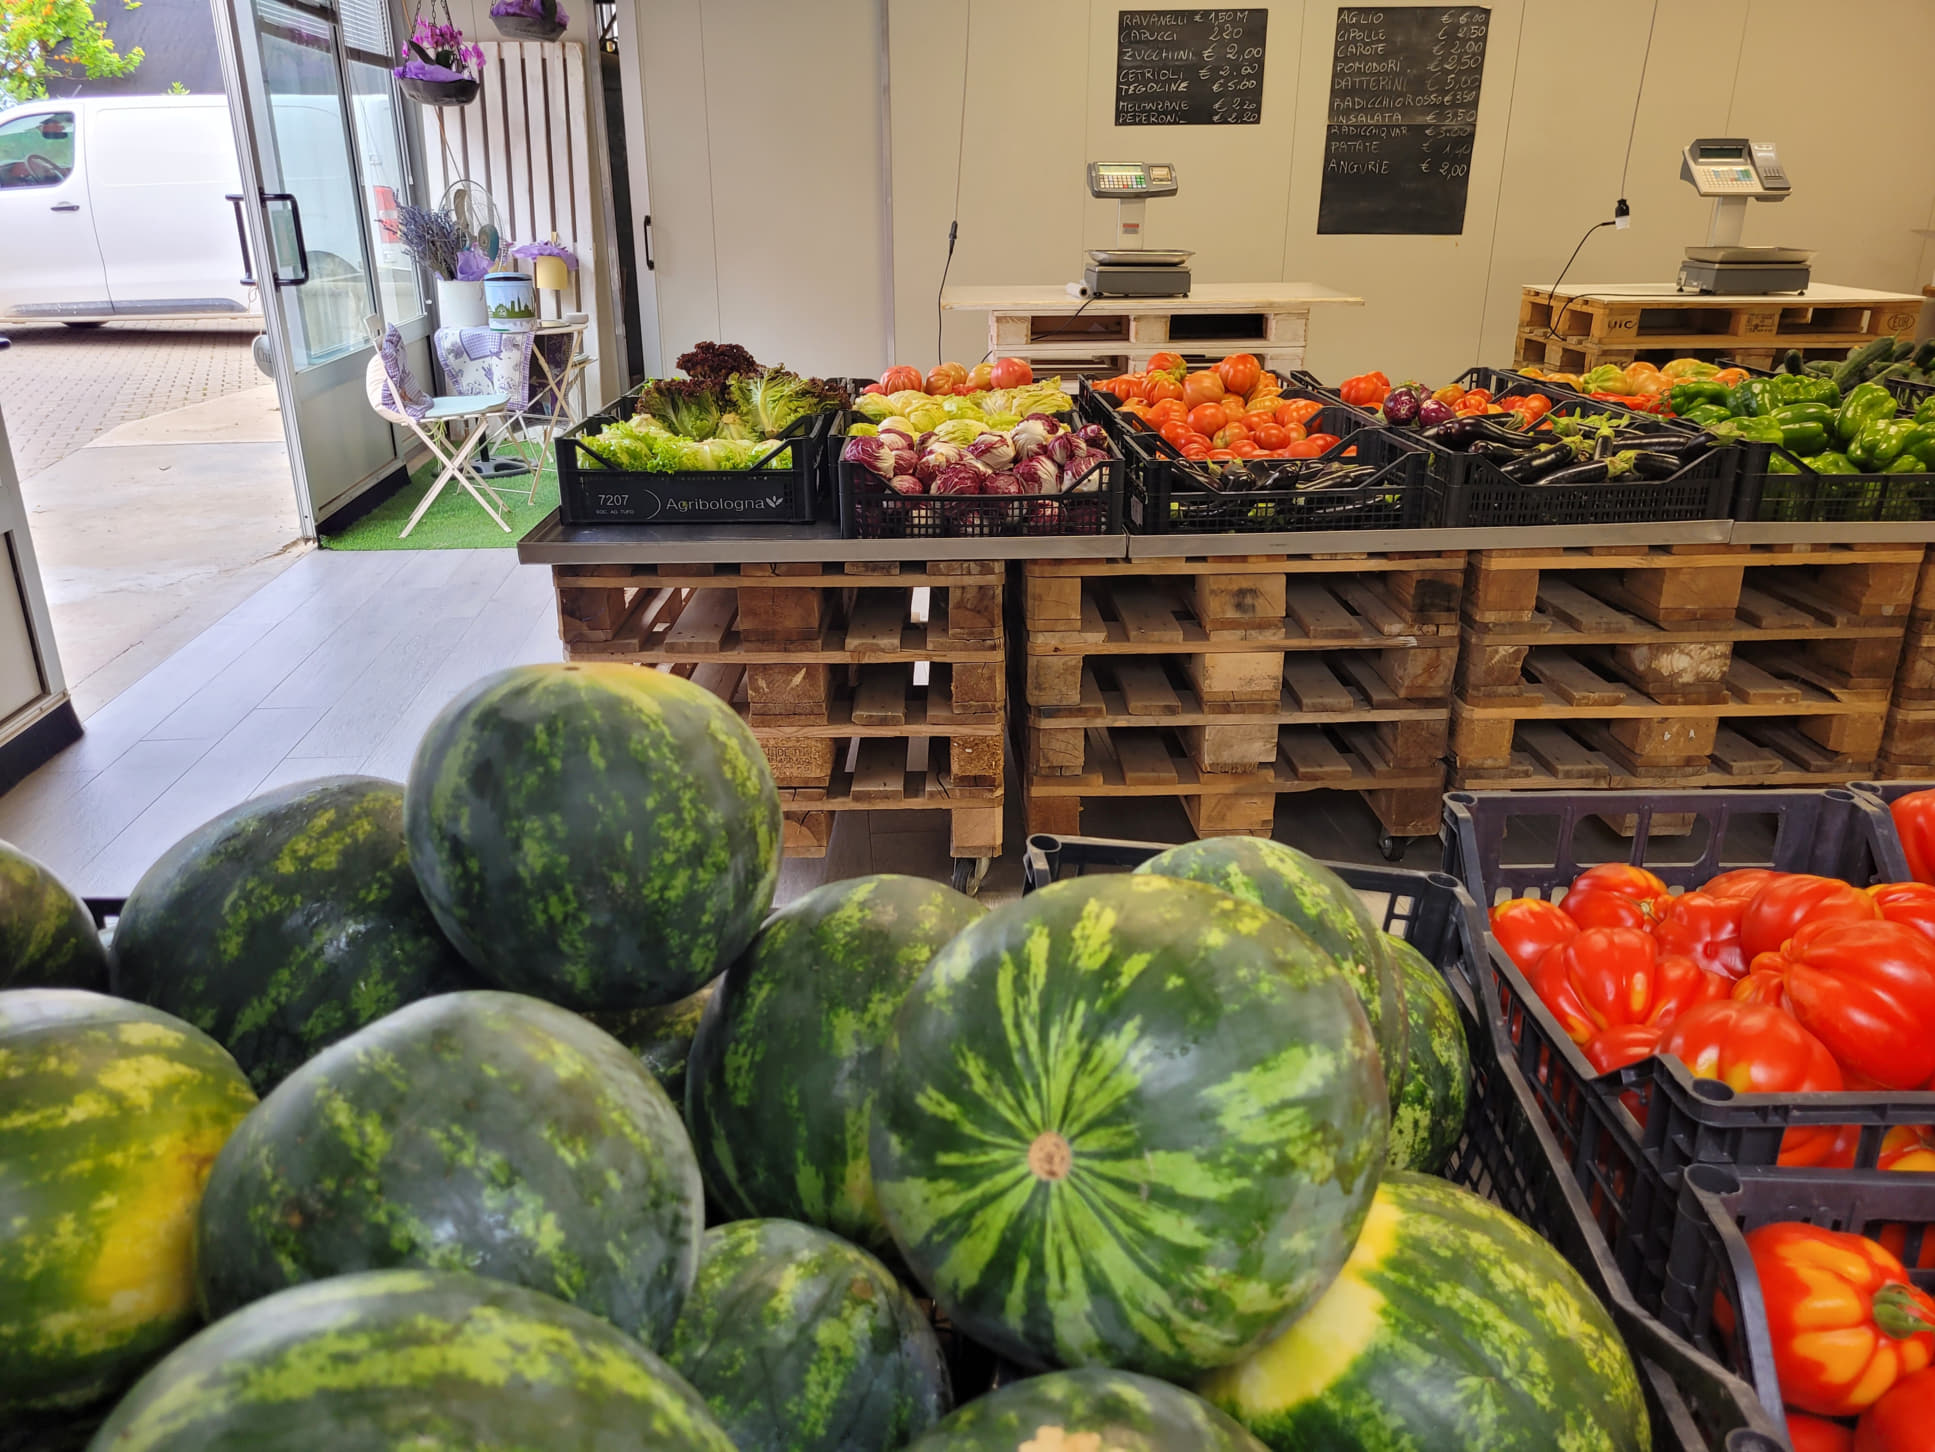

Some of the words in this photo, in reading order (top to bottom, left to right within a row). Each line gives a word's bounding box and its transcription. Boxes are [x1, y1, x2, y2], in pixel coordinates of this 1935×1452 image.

[1123, 13, 1187, 28] RAVANELLI
[1209, 11, 1233, 26] 1,50
[1338, 10, 1384, 24] AGLIO
[1440, 10, 1455, 24] €
[1459, 11, 1486, 24] 6.00
[1337, 28, 1386, 42] CIPOLLE
[1456, 25, 1486, 39] 2,50
[1122, 47, 1193, 61] ZUCCHINI
[1202, 43, 1216, 61] €
[1226, 43, 1262, 62] 2,00
[1337, 43, 1387, 57] CAROTE
[1337, 56, 1402, 73] POMODORI
[1443, 54, 1482, 73] 2,50
[1119, 68, 1183, 82] CETRIOLI
[1198, 65, 1211, 80] €
[1119, 80, 1190, 96] TEGOLINE
[1212, 78, 1224, 93] €
[1334, 76, 1408, 91] DATTERINI
[1119, 100, 1190, 113] MELANZANE
[1212, 98, 1228, 112] €
[1334, 96, 1404, 110] RADICCHIO
[1405, 93, 1442, 106] ROSSO
[1443, 91, 1455, 106] €
[1212, 112, 1224, 123] €
[1334, 112, 1402, 125] INSALATA
[1426, 110, 1440, 123] €
[1444, 109, 1477, 124] 3,50
[1331, 140, 1381, 153] PATATE
[1328, 159, 1391, 175] ANGURIE
[1418, 158, 1432, 173] €
[1439, 161, 1467, 180] 2,00
[597, 494, 629, 506] 7207
[666, 497, 765, 513] Agribologna
